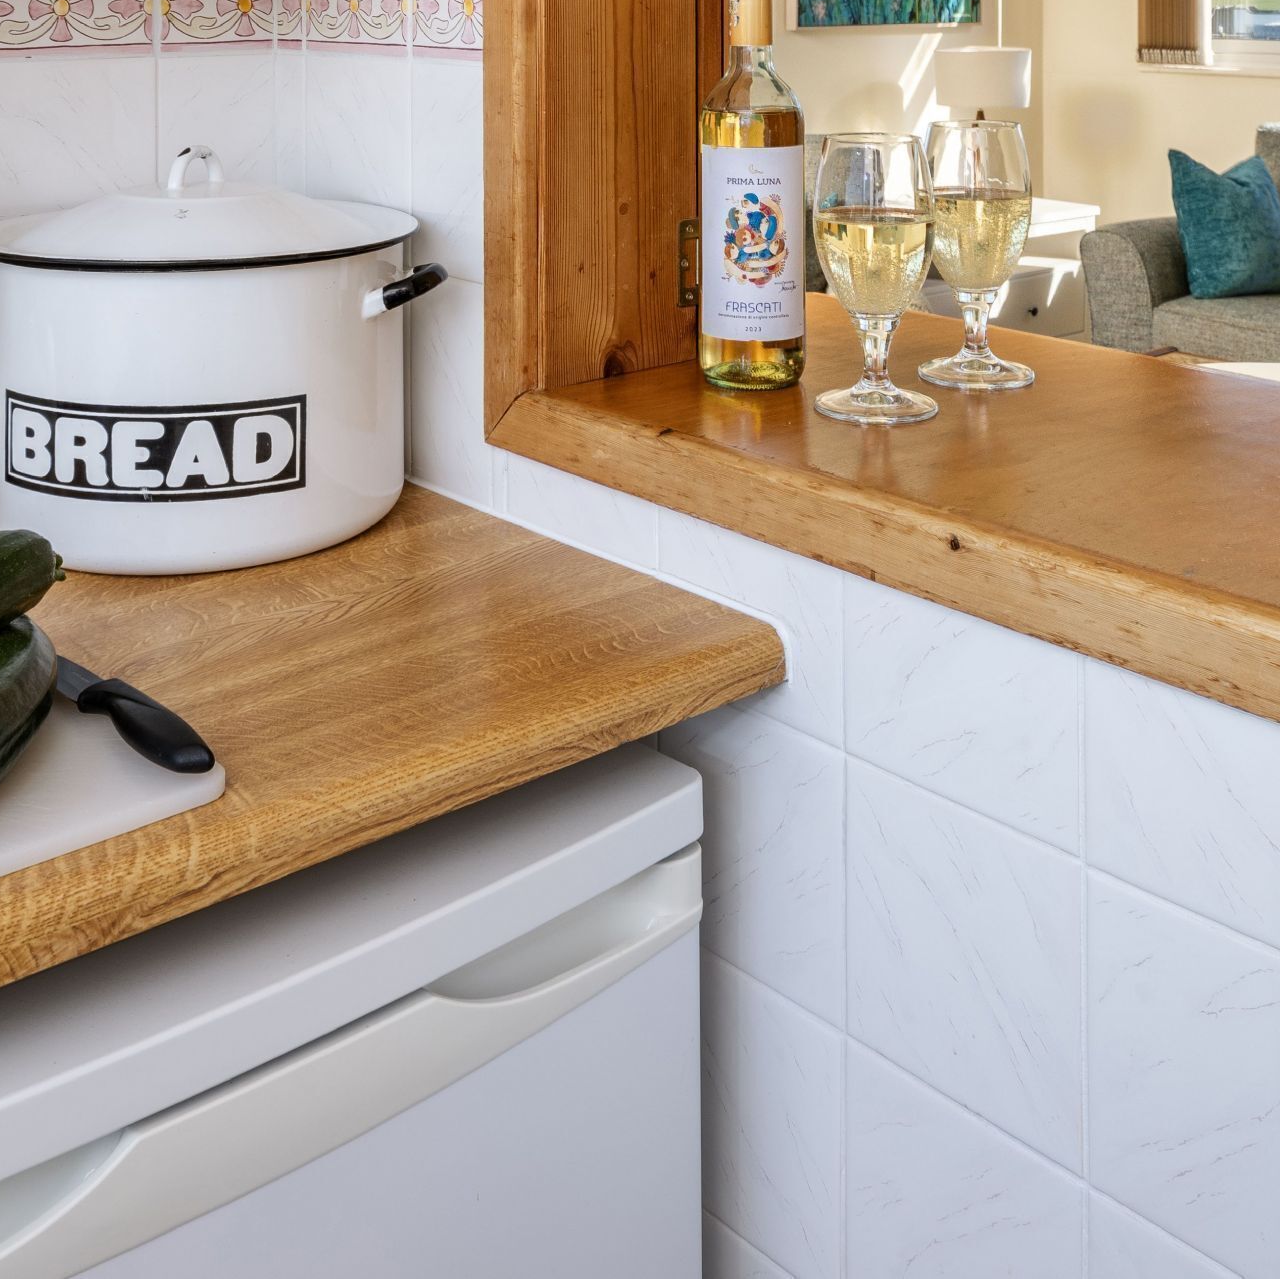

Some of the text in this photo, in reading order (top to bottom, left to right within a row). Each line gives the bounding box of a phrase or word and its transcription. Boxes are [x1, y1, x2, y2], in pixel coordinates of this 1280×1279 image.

[726, 177, 782, 186] PRIMA LUNA
[725, 301, 782, 314] FRASCATI
[11, 407, 295, 488] BREAD
